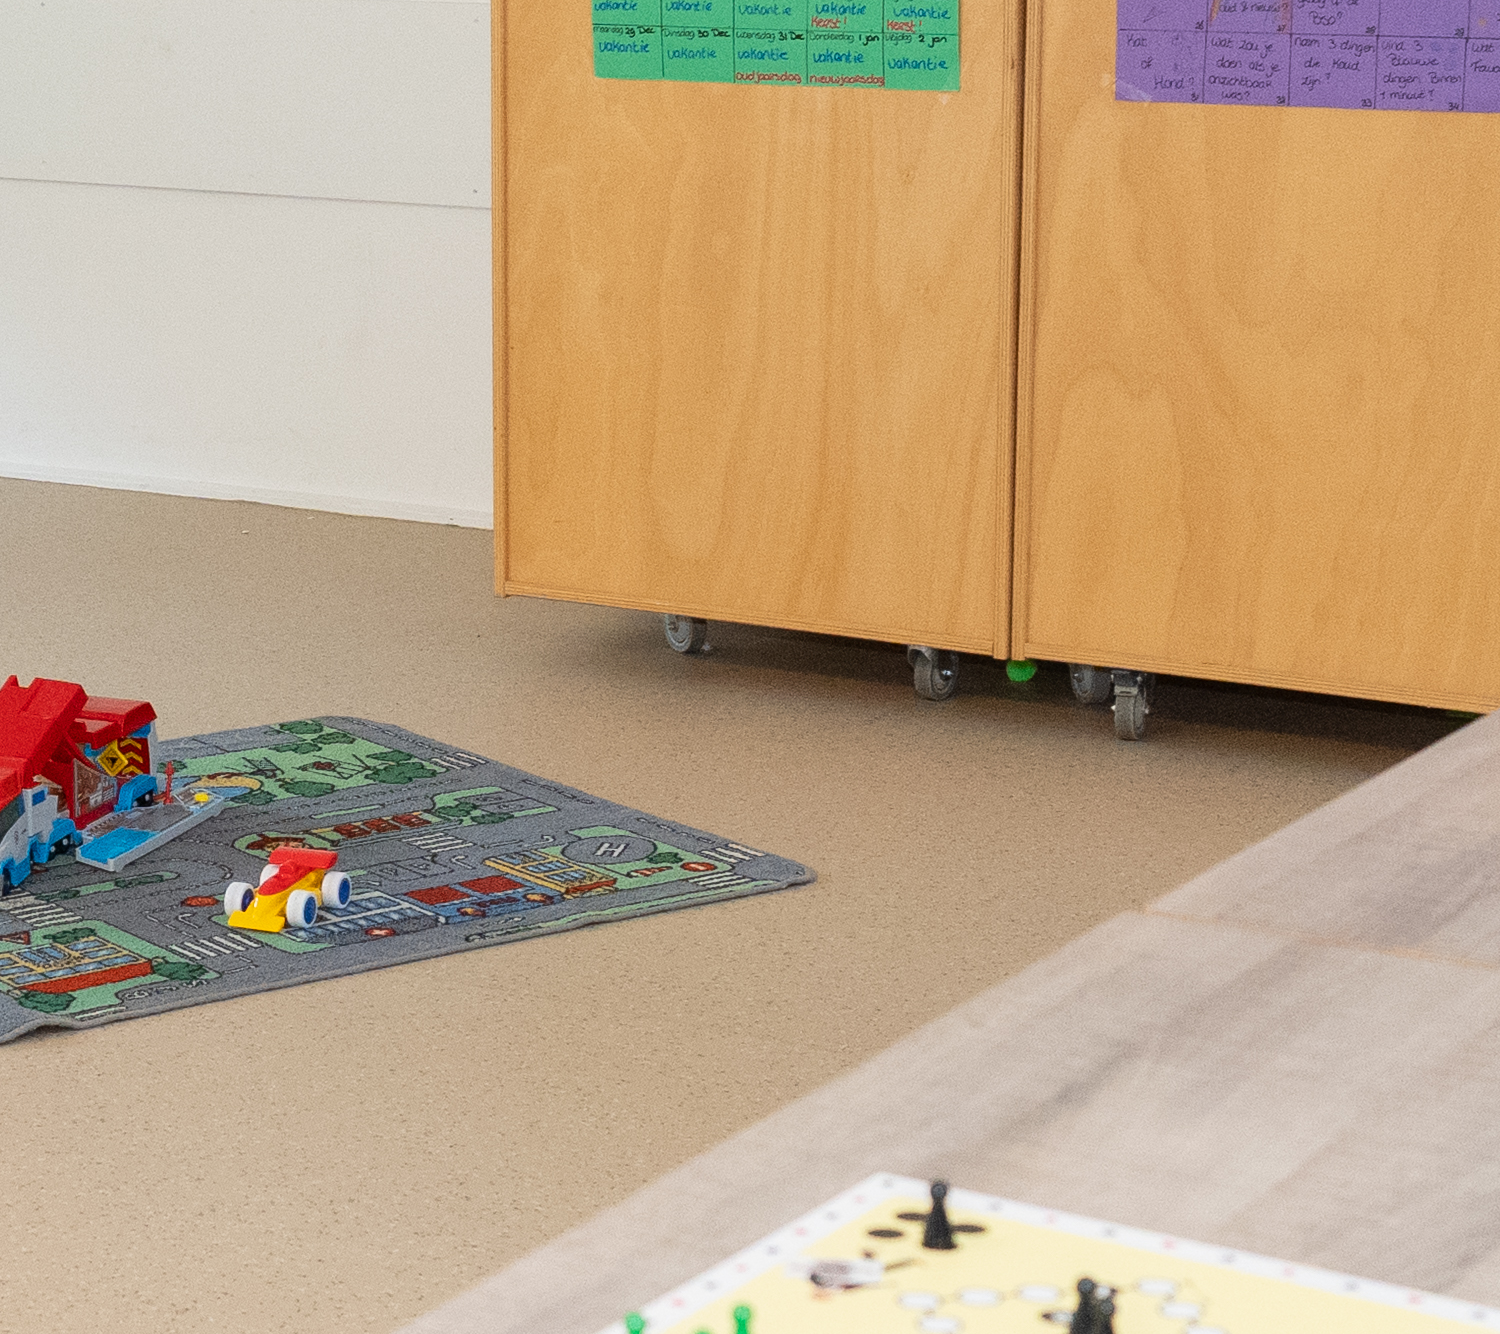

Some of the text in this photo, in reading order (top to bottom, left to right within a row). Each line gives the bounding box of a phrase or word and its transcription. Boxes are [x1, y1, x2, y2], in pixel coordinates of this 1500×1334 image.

[638, 26, 655, 34] Dec
[712, 29, 731, 38] Dec
[929, 35, 947, 47] jan
